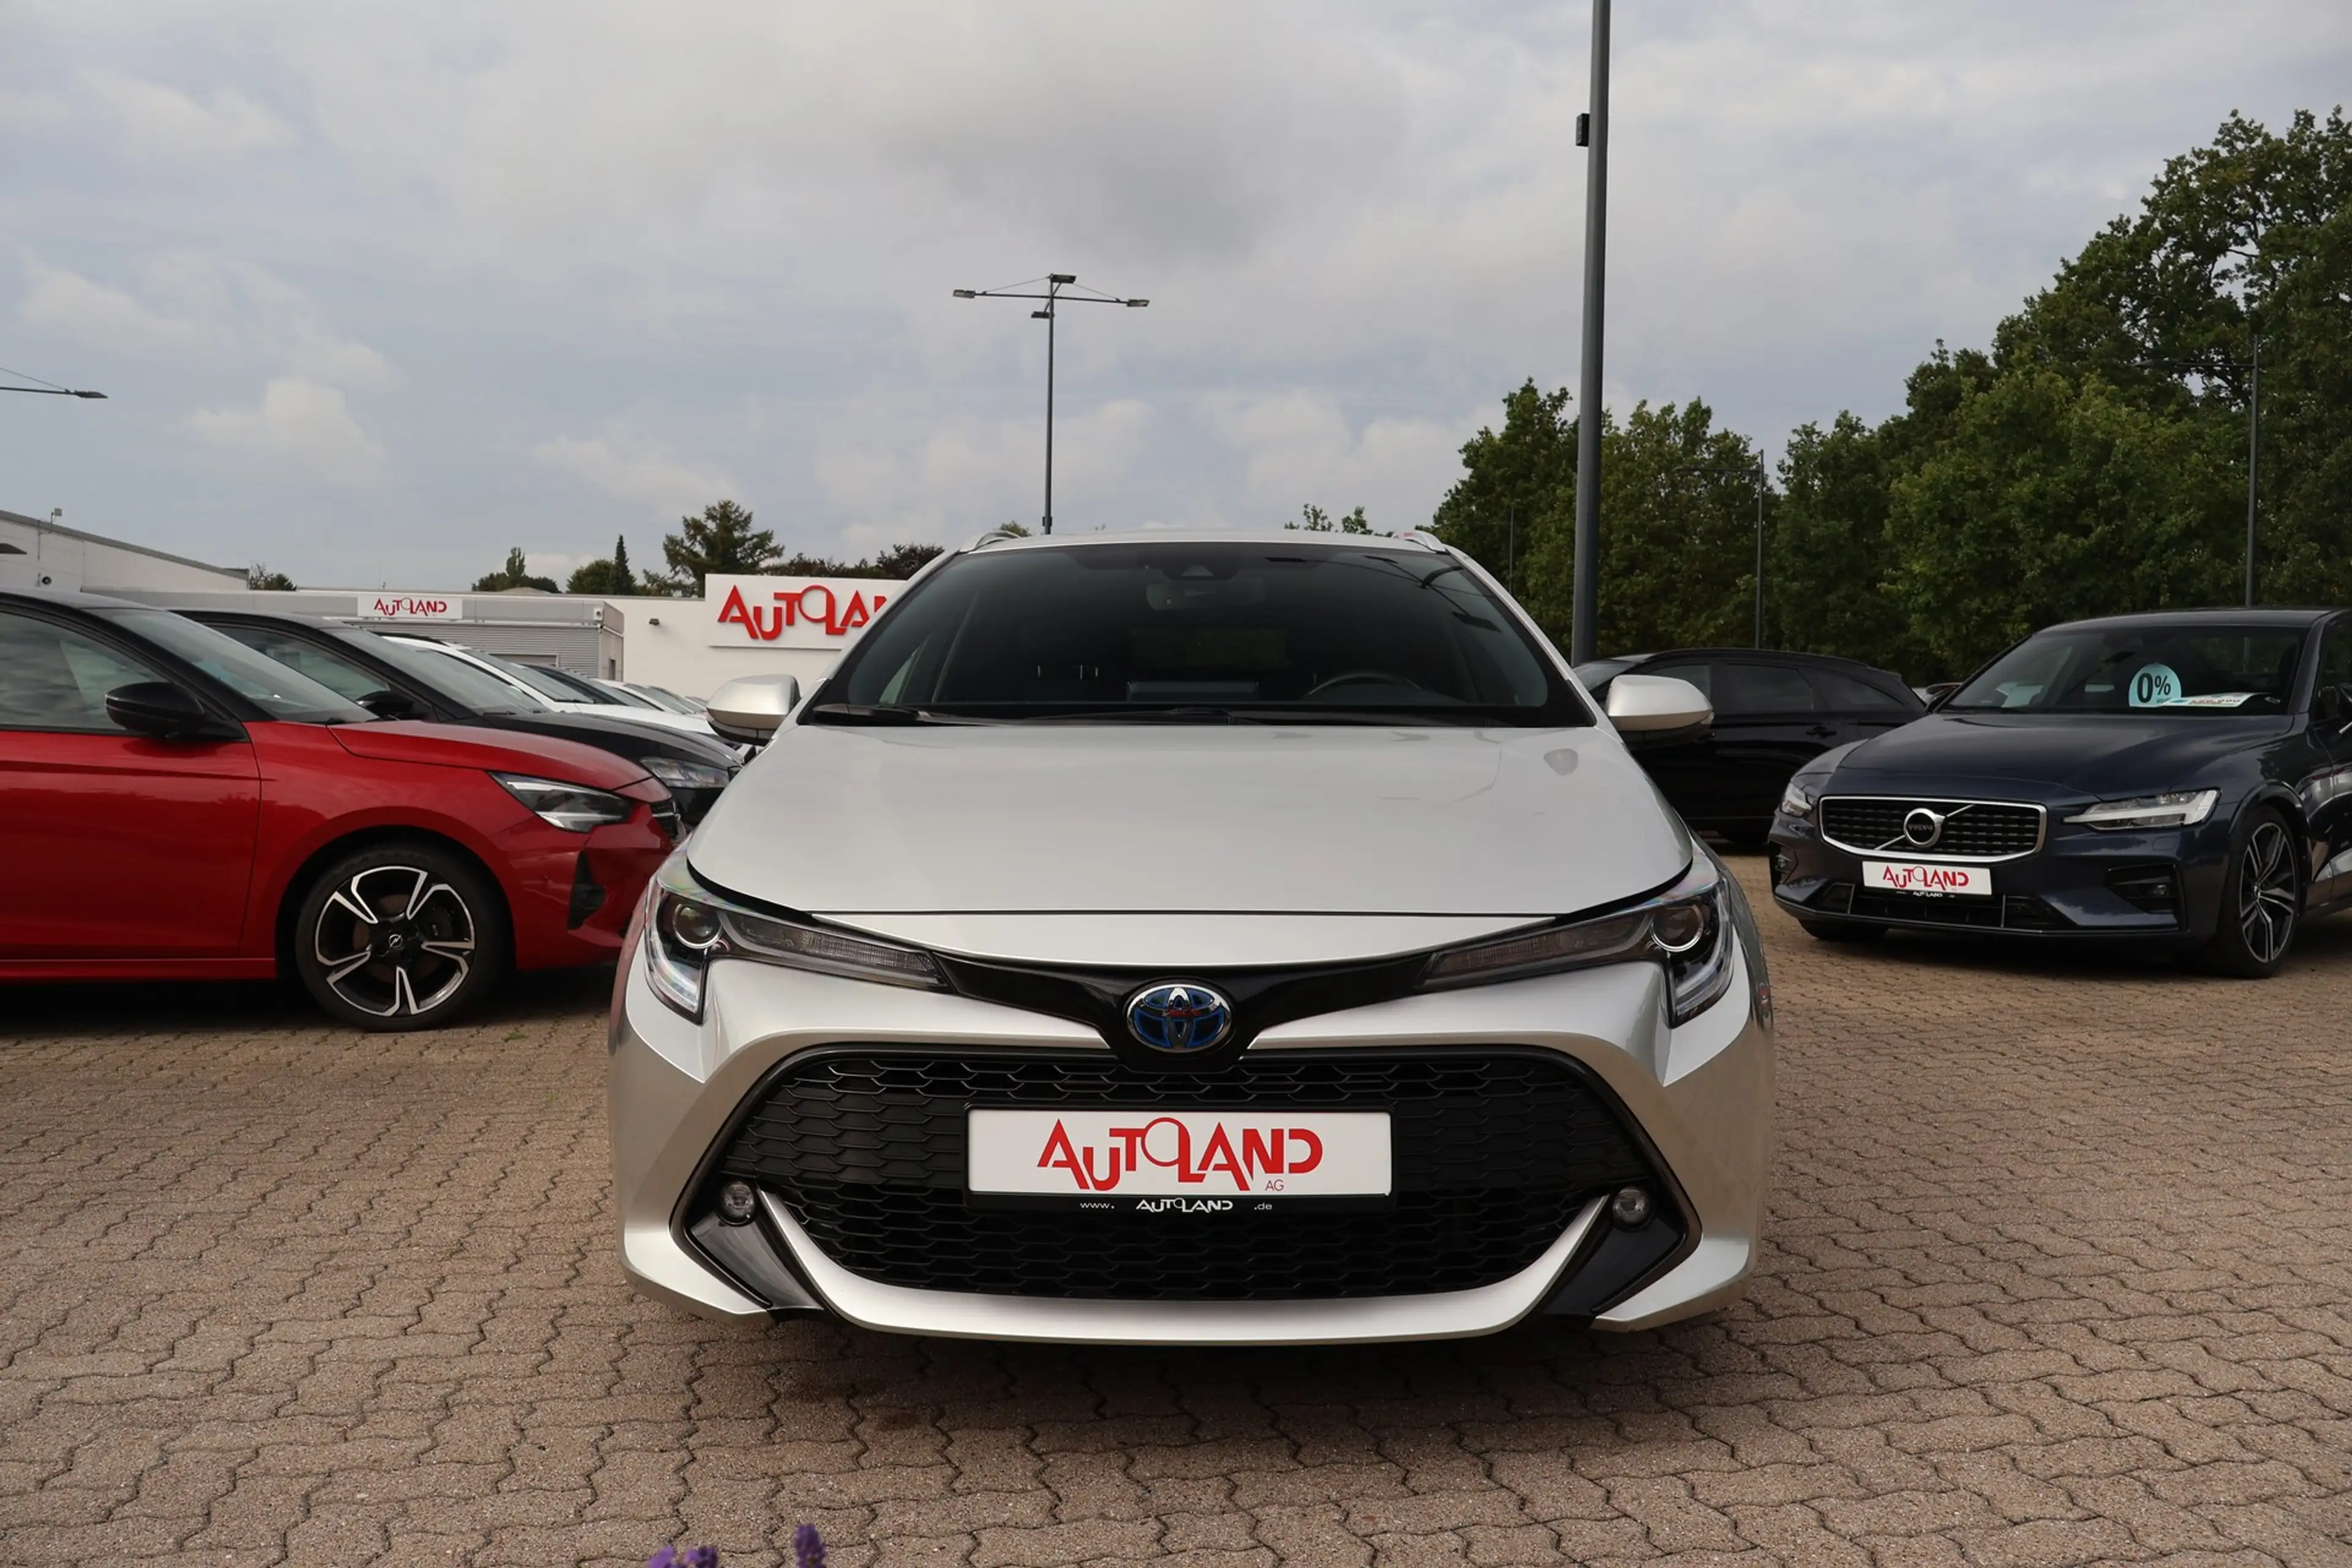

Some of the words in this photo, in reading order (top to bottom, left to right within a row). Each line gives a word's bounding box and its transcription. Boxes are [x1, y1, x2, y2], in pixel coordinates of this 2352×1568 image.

[374, 597, 447, 616] AUTOLAND
[718, 584, 887, 641] AUTOLA
[2137, 673, 2171, 703] 0%
[1883, 865, 1970, 891] AUTOLAND
[1037, 1117, 1324, 1192] AUTOLAND
[1265, 1180, 1284, 1192] AG
[1135, 1197, 1234, 1213] AUTOLAND
